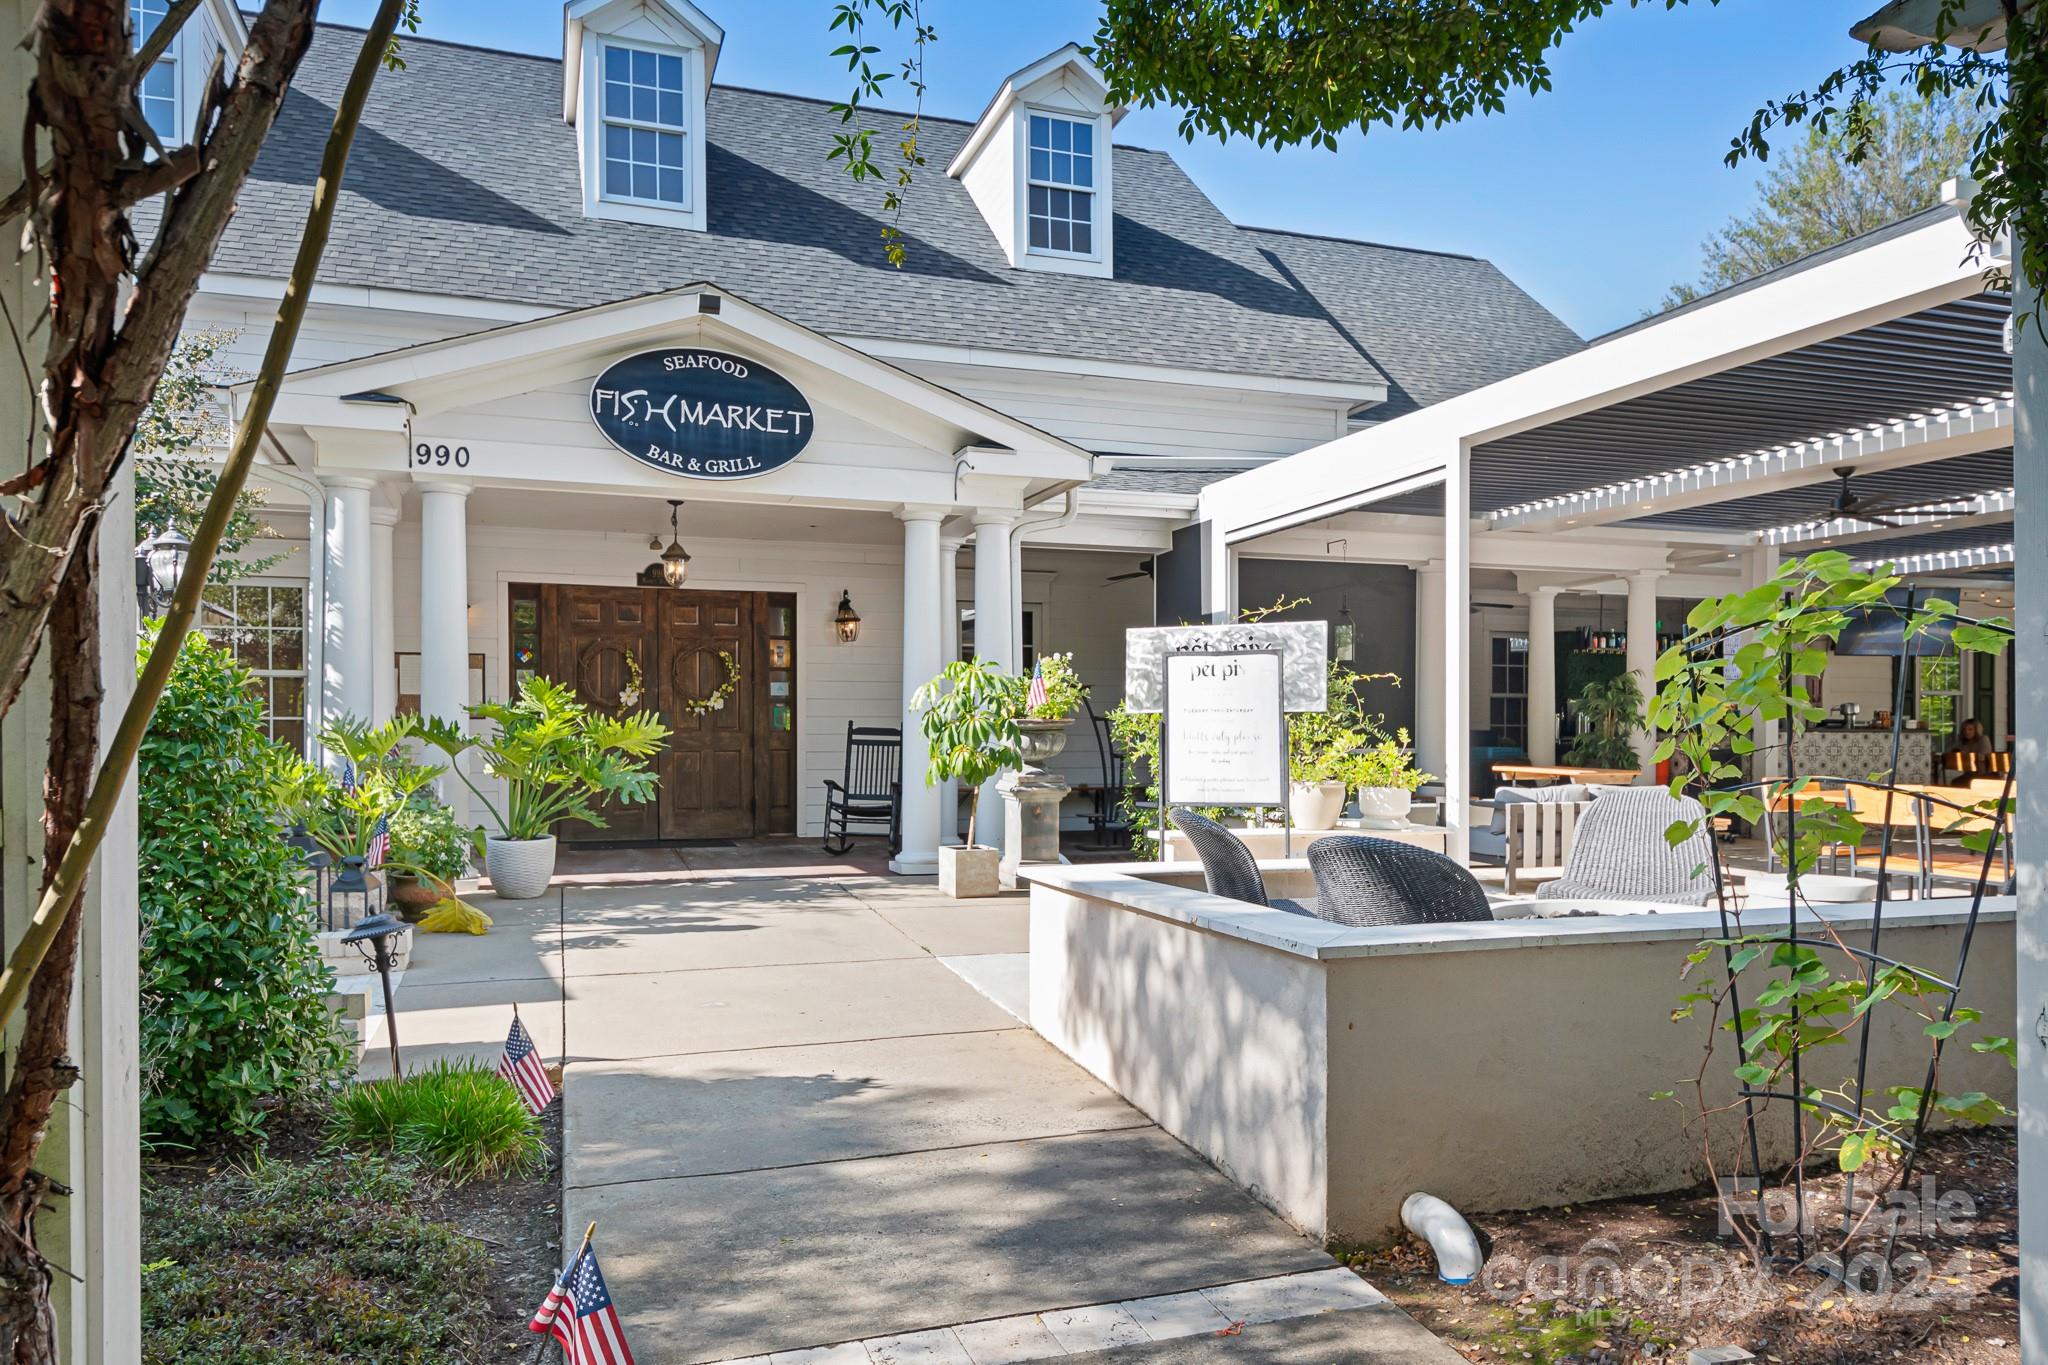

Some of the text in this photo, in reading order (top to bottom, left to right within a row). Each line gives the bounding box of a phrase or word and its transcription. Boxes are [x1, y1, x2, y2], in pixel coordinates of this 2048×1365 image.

[663, 354, 749, 379] SEAFOOD
[415, 443, 470, 468] 990
[646, 444, 762, 473] BAR & GRILL
